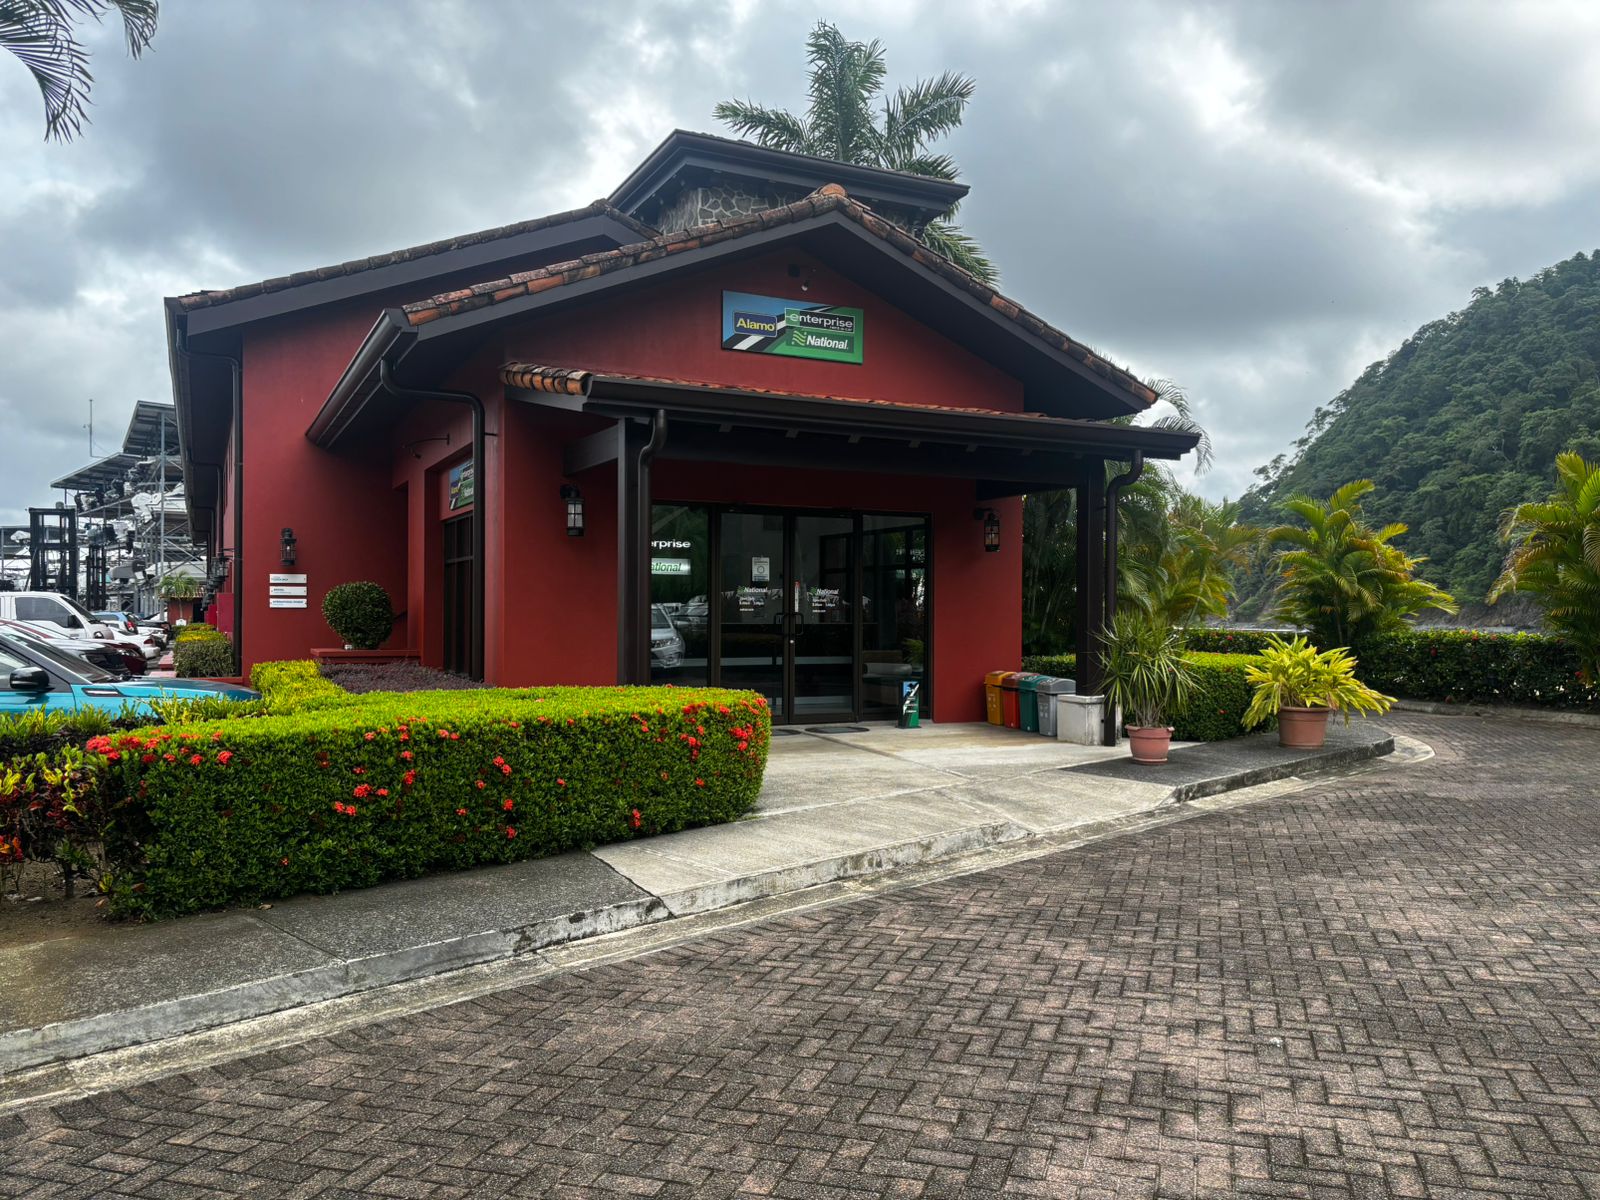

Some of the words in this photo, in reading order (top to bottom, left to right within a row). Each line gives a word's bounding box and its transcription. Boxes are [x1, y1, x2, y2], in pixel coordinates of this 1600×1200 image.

[736, 317, 776, 332] Alamo
[787, 312, 853, 329] enterprise
[806, 334, 848, 351] National
